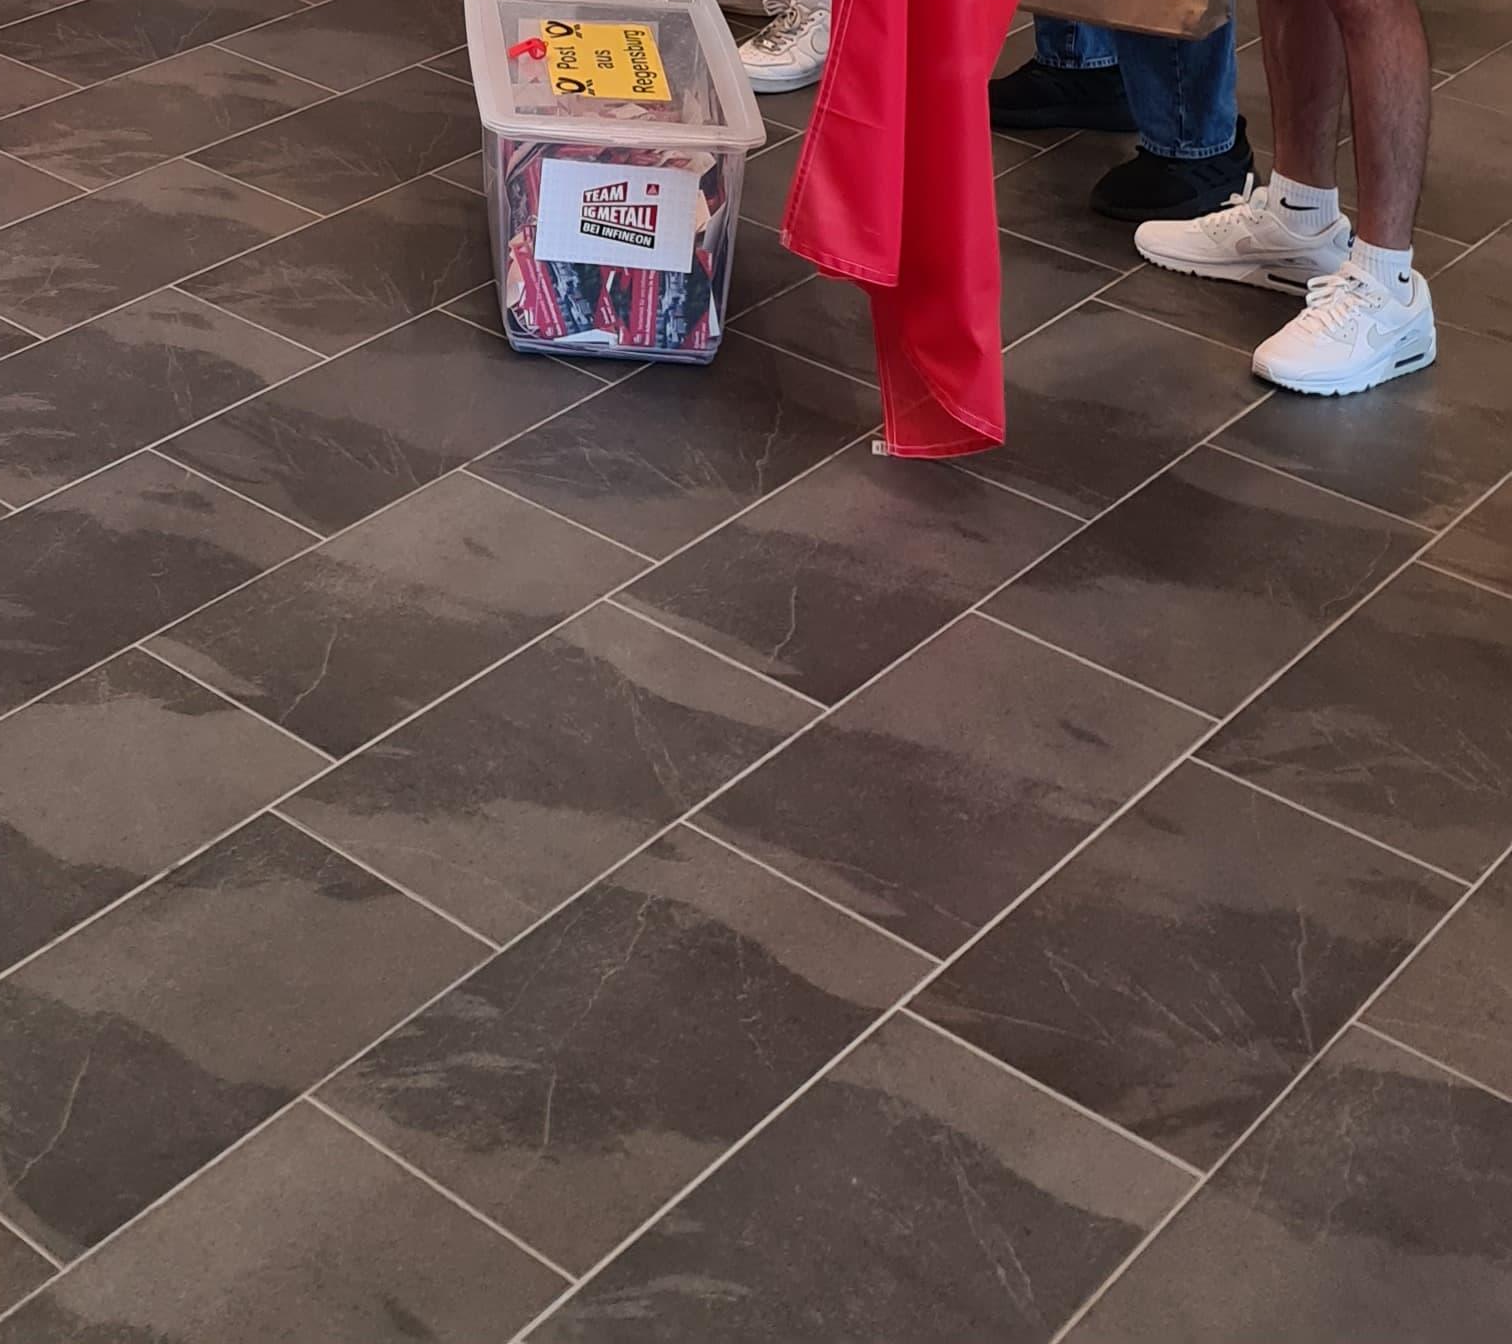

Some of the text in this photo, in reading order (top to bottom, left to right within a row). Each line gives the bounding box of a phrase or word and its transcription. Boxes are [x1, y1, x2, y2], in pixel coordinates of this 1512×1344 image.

[554, 46, 579, 70] Post
[595, 49, 614, 69] aus
[624, 30, 657, 94] Regensburg
[584, 185, 624, 202] TEAM
[583, 206, 653, 230] IG METALL
[582, 222, 652, 246] BEI INFINEON
